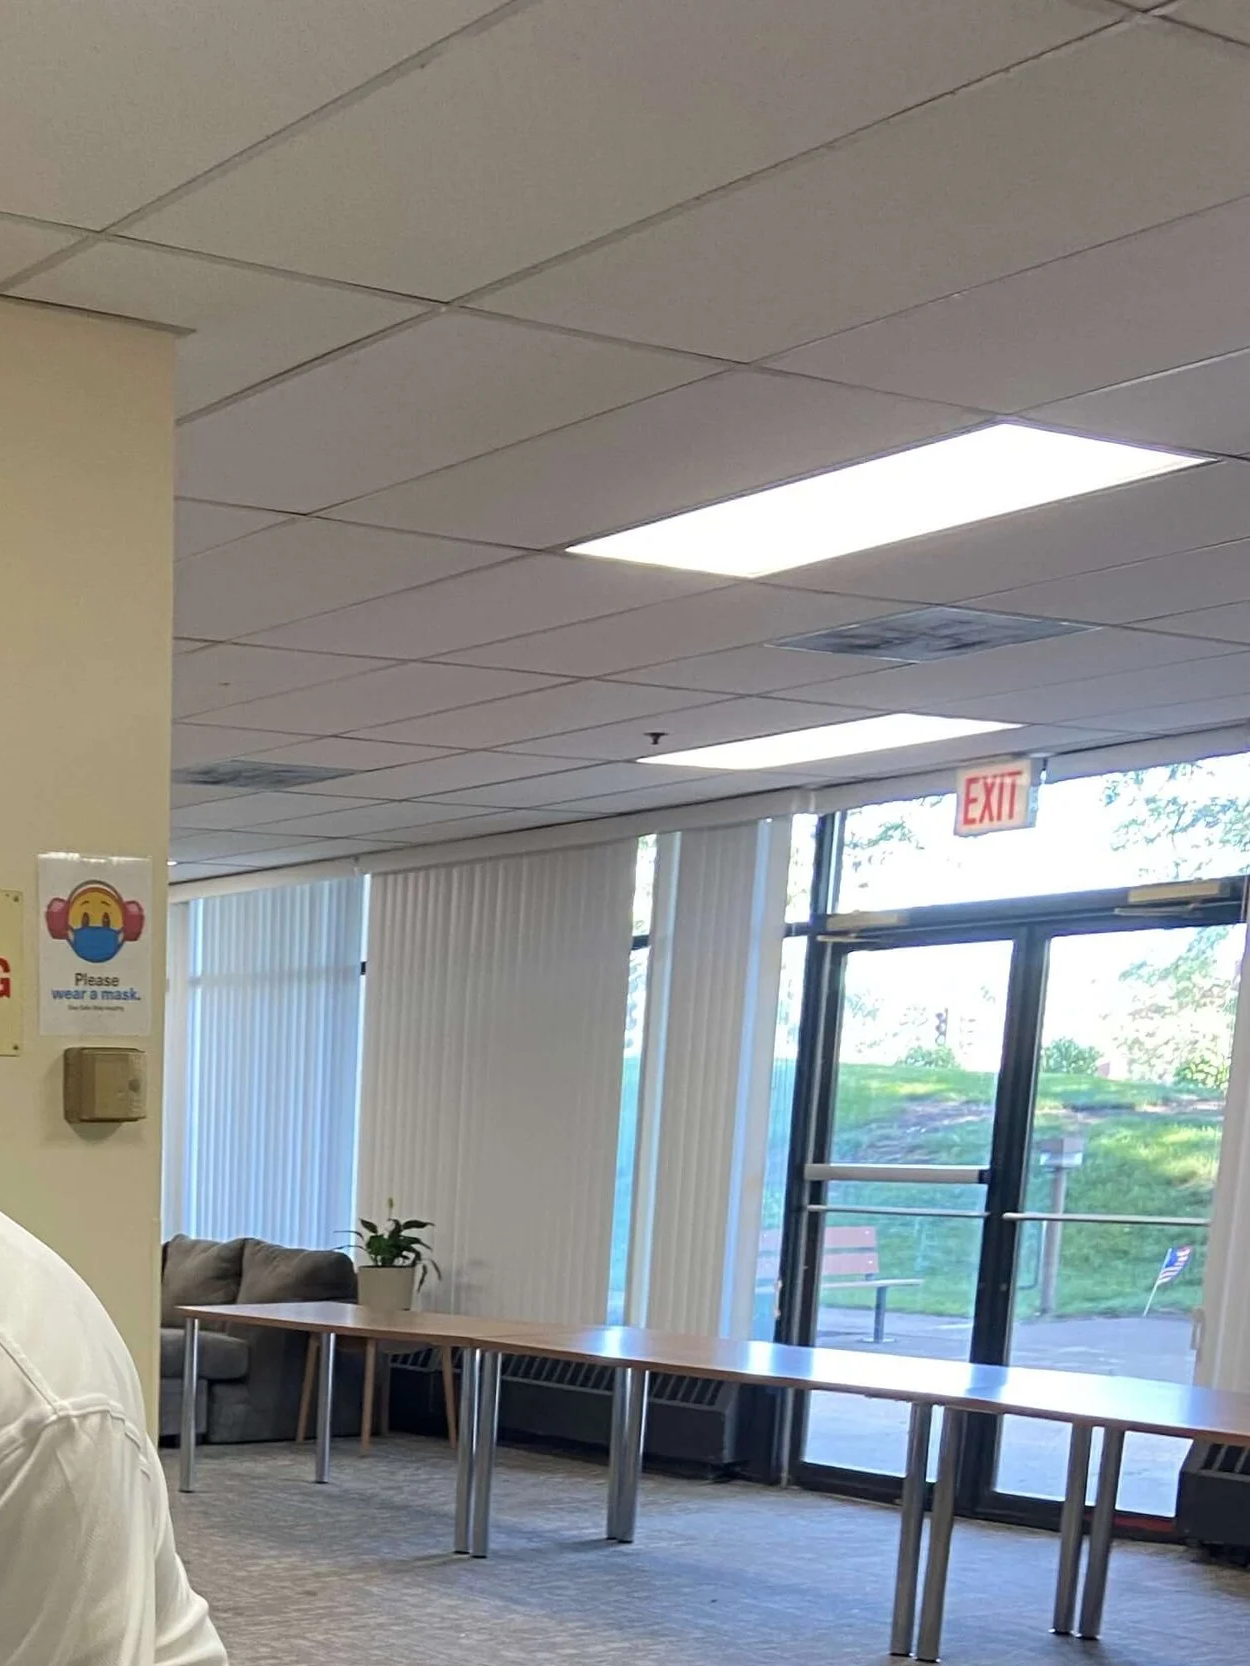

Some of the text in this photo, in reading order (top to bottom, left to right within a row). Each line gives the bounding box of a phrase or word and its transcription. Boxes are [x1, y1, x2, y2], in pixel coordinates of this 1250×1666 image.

[963, 770, 1023, 825] EXIT
[74, 972, 120, 987] Please
[52, 987, 141, 1001] wear a mask.
